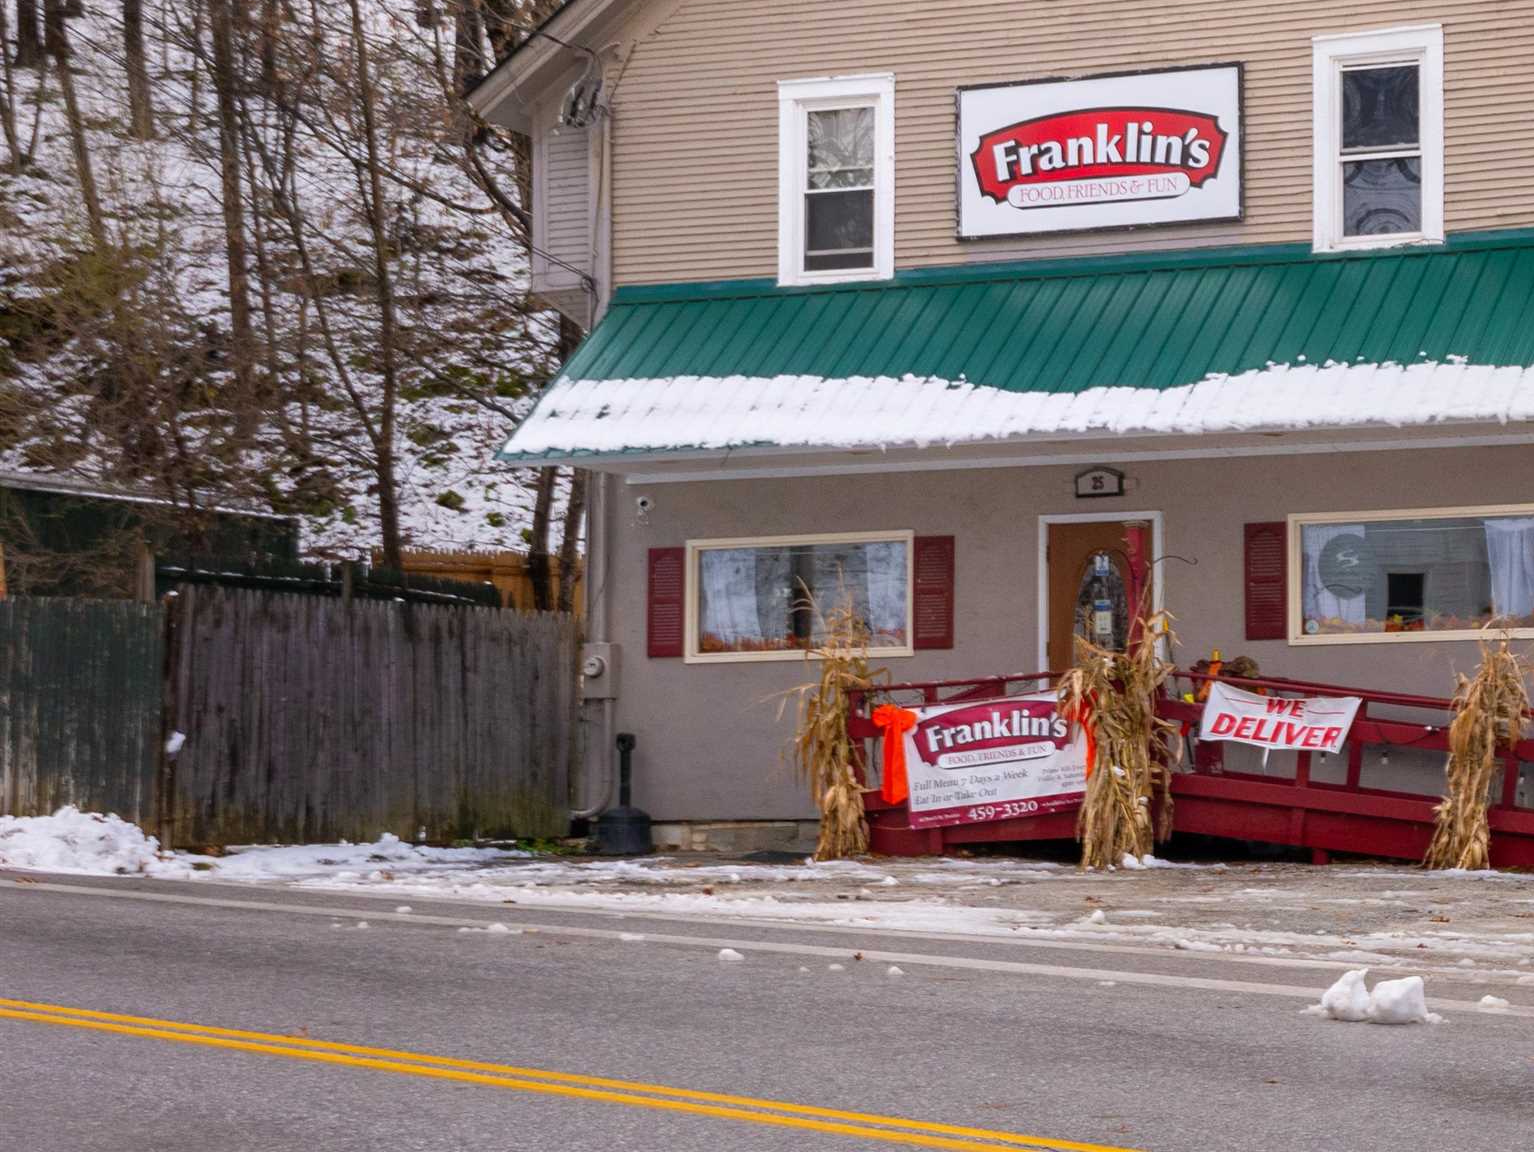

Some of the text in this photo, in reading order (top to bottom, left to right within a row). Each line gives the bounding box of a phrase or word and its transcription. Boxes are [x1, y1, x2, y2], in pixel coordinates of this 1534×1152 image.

[992, 121, 1210, 182] Franklin's
[1067, 183, 1129, 199] FRIENDS
[1130, 181, 1146, 194] &
[1147, 178, 1178, 193] FUN
[1265, 698, 1306, 717] WE
[926, 708, 1067, 752] Franklin's
[1210, 713, 1342, 748] DELIVER
[978, 750, 1017, 762] FRIENDS
[1027, 744, 1047, 755] FUN
[913, 779, 931, 791] Full
[933, 777, 959, 789] Menu
[970, 775, 993, 786] Days
[1003, 768, 1028, 780] Week
[954, 790, 976, 801] Take
[978, 787, 998, 798] Out
[968, 800, 1038, 821] 459-3320
